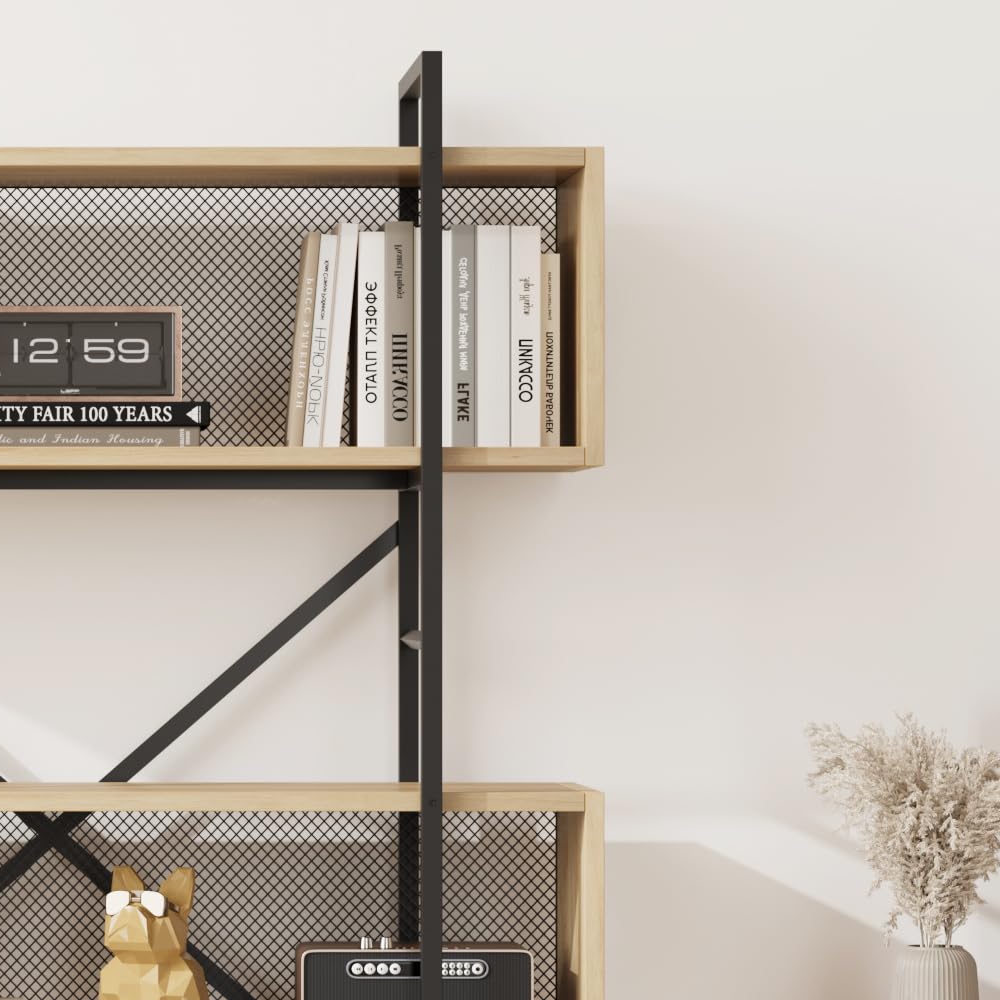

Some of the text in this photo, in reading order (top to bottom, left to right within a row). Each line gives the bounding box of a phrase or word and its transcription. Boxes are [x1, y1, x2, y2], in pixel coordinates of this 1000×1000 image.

[32, 405, 74, 422] FAIR
[80, 405, 109, 422] 100
[112, 405, 173, 422] YEARS
[19, 433, 48, 445] and
[52, 433, 100, 445] Indian
[106, 433, 165, 447] Housing
